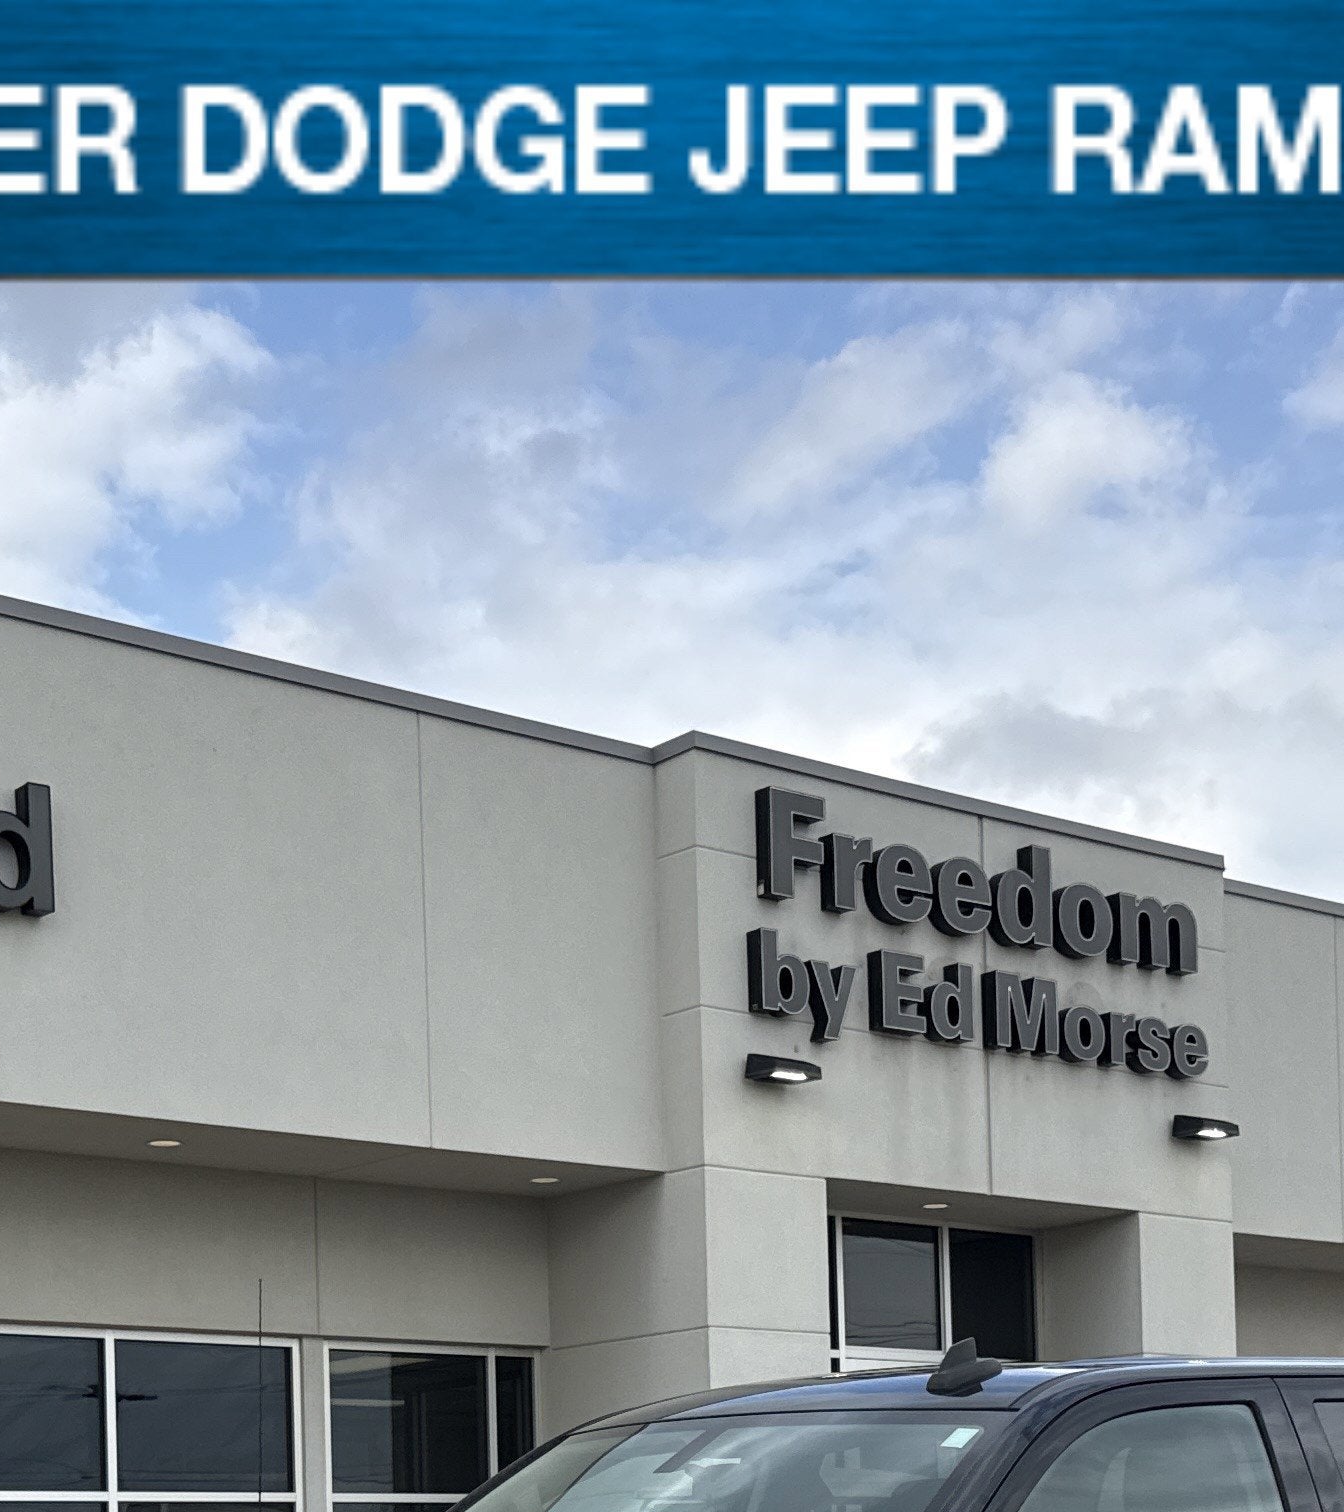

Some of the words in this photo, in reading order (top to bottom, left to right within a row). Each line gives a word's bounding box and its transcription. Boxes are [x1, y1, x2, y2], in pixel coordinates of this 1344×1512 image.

[755, 786, 1199, 976] Freedom
[747, 927, 856, 1043] by
[867, 949, 974, 1043] Ed
[982, 969, 1209, 1080] Morse
